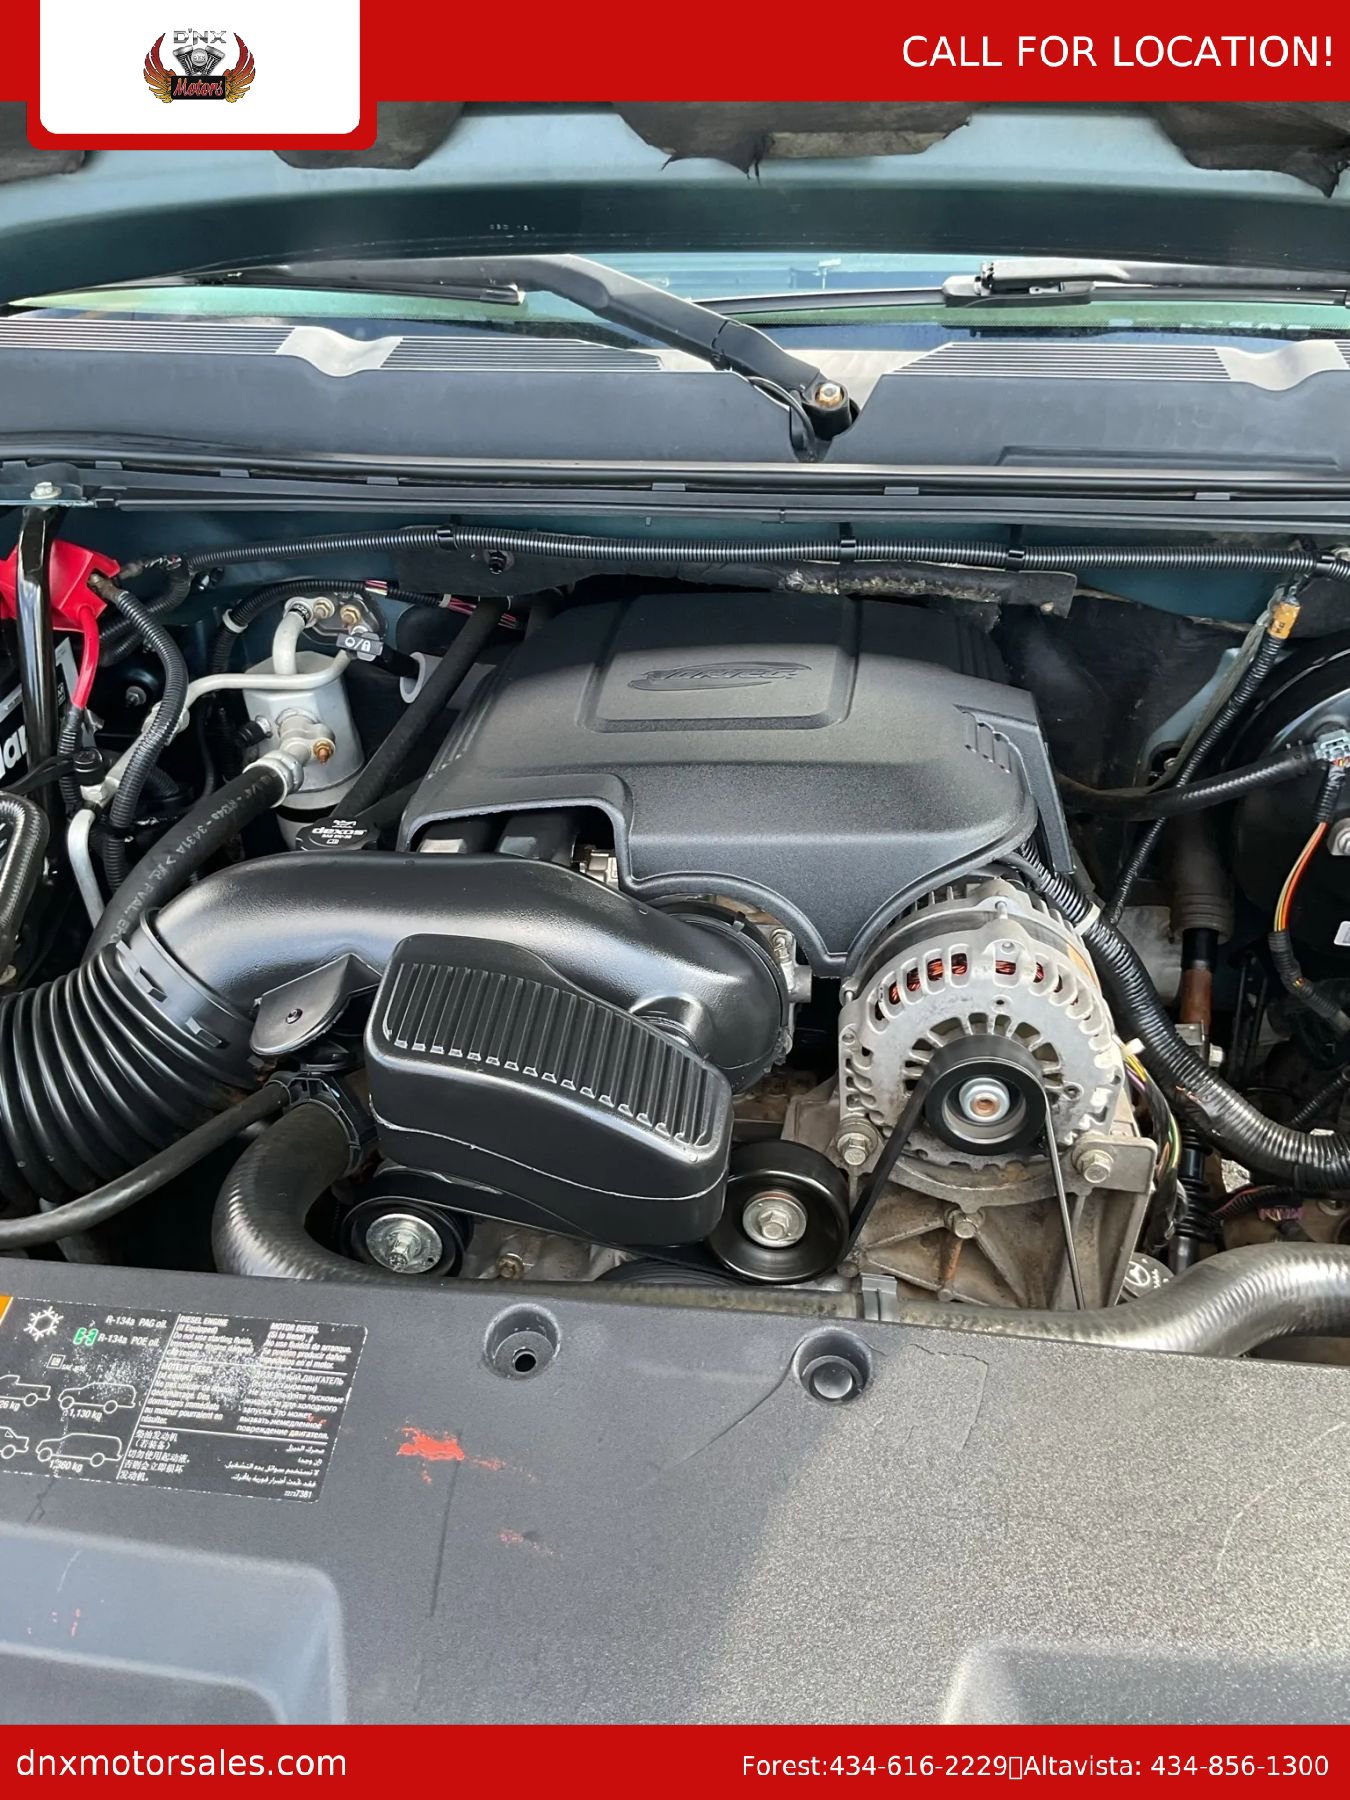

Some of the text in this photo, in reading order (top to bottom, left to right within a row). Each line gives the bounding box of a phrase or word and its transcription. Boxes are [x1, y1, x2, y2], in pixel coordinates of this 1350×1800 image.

[105, 1316, 135, 1325] R-134a
[138, 1319, 155, 1327] PAG
[97, 1334, 128, 1343] R-134a
[297, 1351, 324, 1359] producir
[302, 1375, 344, 1384] ДВИГАТЕЛЬ
[308, 1395, 343, 1403] пусковые
[9, 1401, 21, 1412] kg
[69, 1408, 103, 1421] 1,130 kg
[71, 1462, 84, 1473] kg
